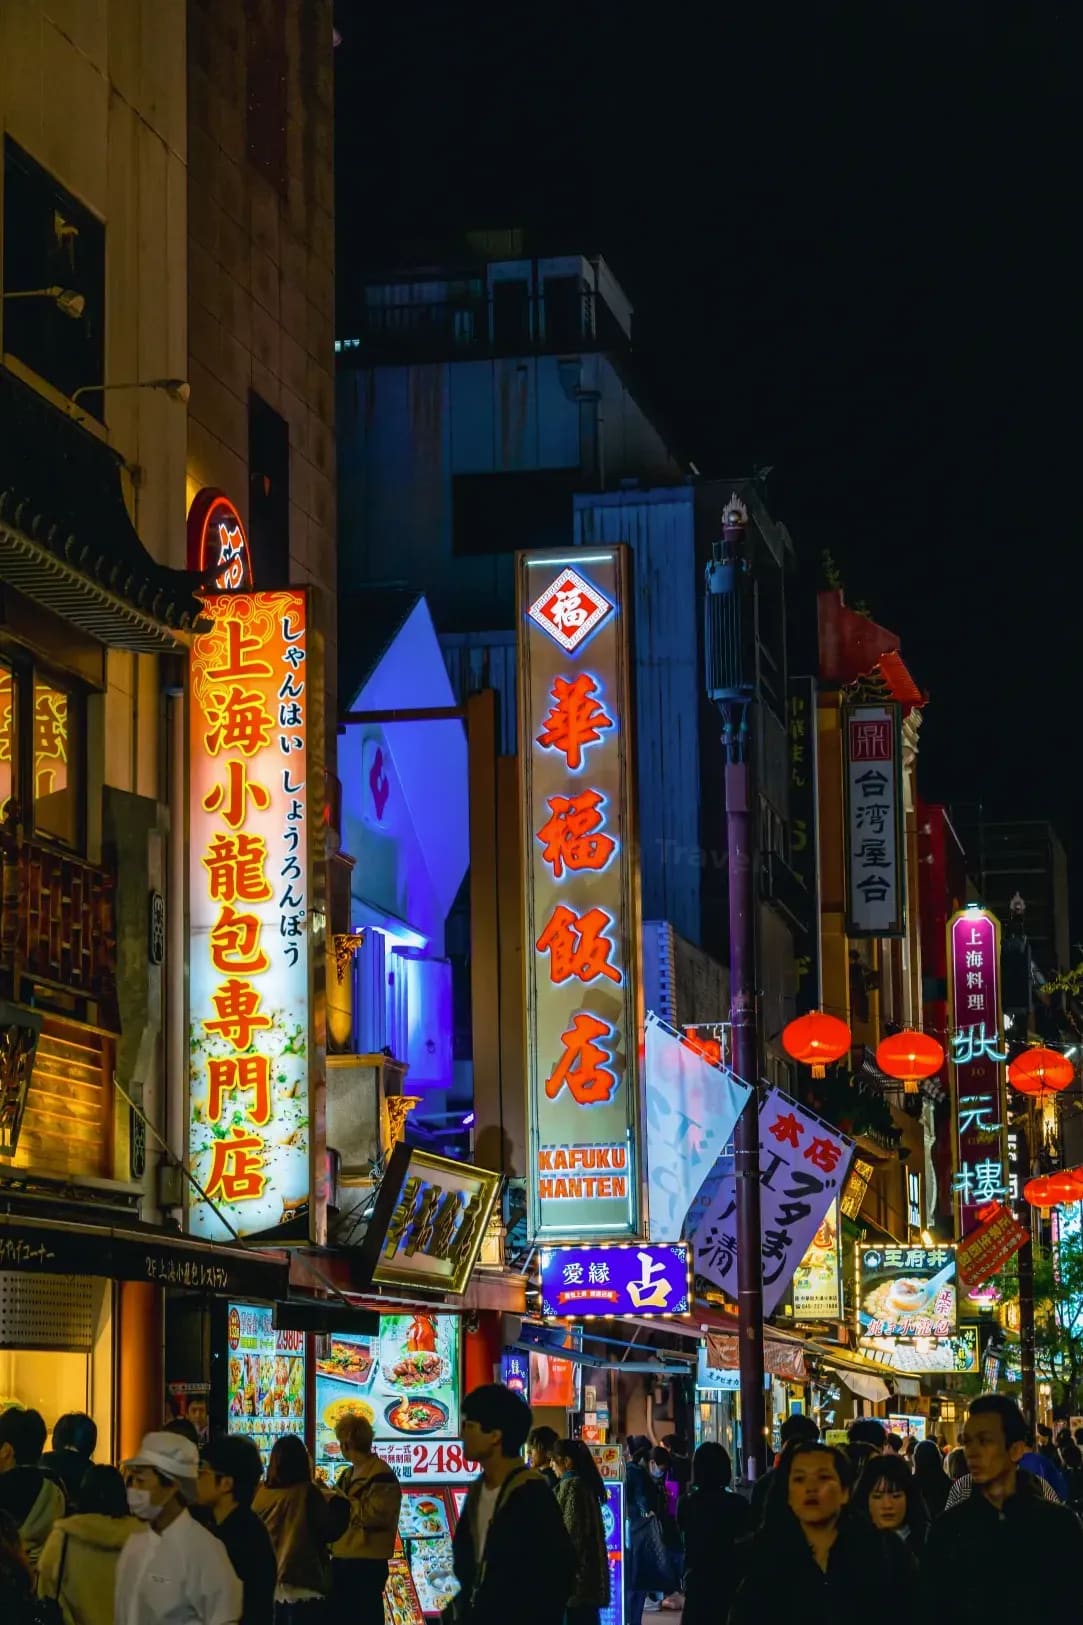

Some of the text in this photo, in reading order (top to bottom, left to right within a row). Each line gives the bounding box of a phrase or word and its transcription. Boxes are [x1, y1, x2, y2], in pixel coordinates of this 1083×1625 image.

[552, 588, 590, 630] 福
[280, 616, 305, 967] しゃんはい しょうろんぽう
[854, 769, 892, 903] 台湾屋台
[202, 616, 273, 1202] 上海小龍包専門店
[536, 673, 622, 1104] 華福飯店
[965, 927, 986, 1012] 上海料理
[539, 1148, 626, 1170] KAFUKU
[769, 1112, 843, 1174] 本店
[539, 1176, 626, 1199] HANTEN
[562, 1262, 611, 1285] 愛縁
[626, 1251, 673, 1308] 占
[884, 1249, 948, 1267] 王府井
[937, 1289, 952, 1313] 正宗
[413, 1444, 483, 1474] 2480
